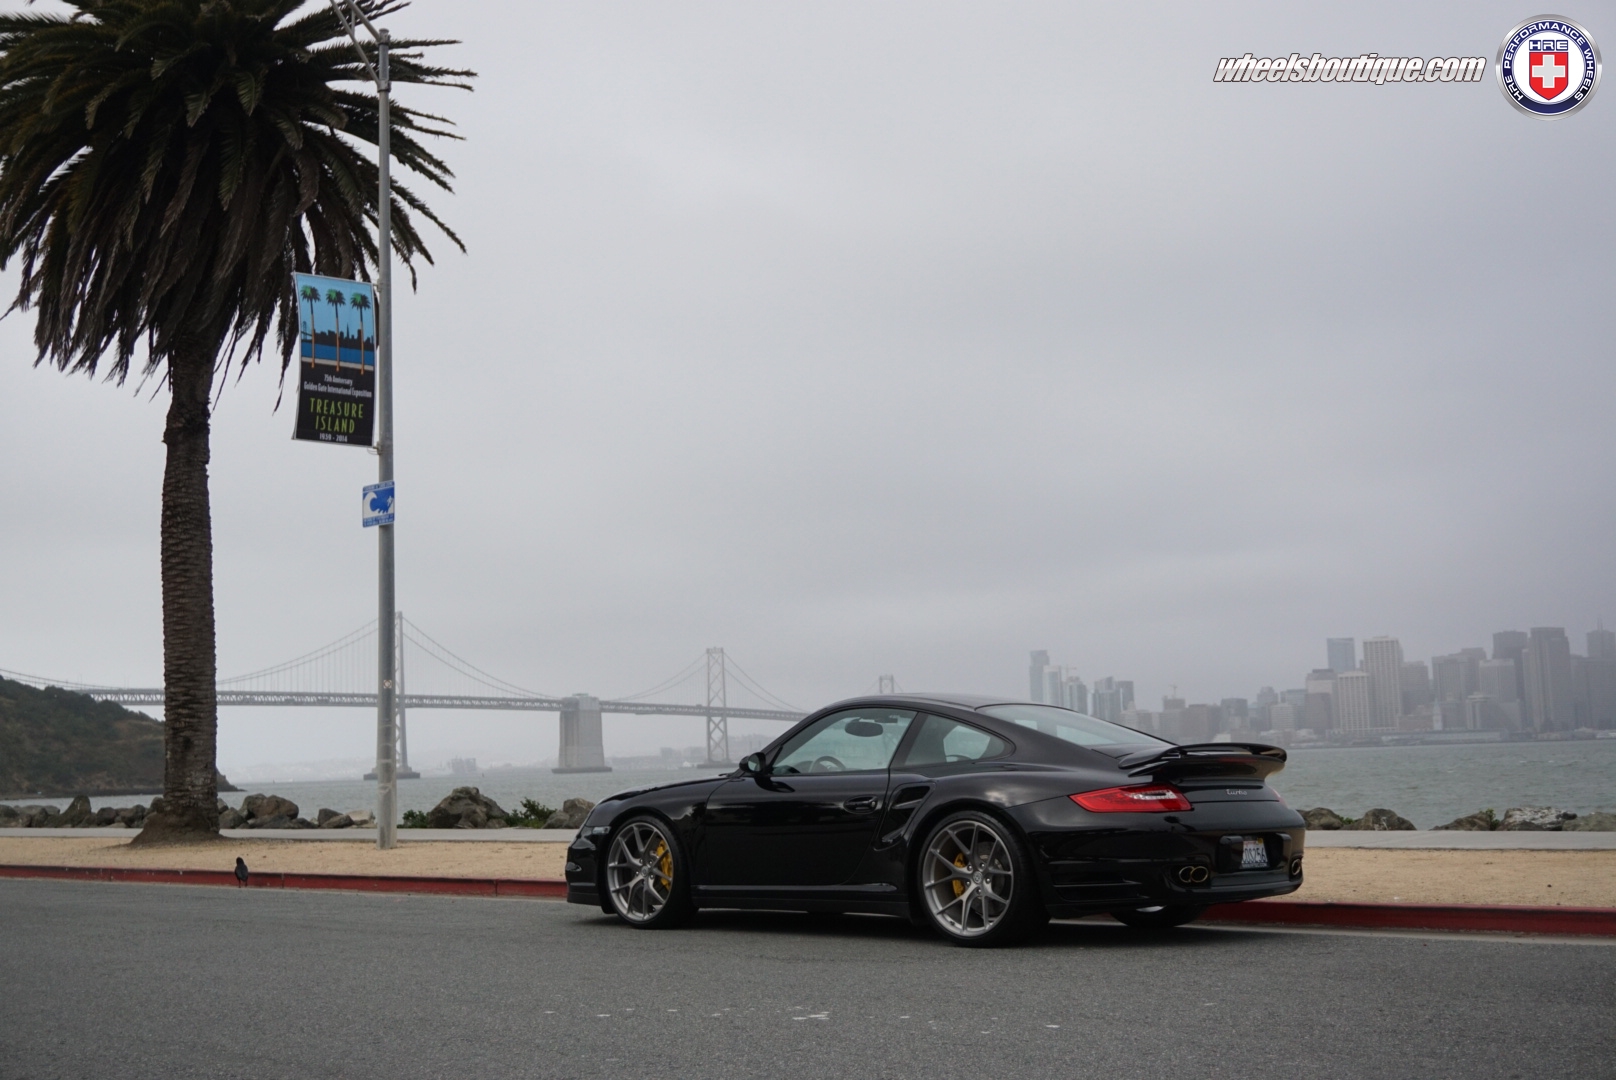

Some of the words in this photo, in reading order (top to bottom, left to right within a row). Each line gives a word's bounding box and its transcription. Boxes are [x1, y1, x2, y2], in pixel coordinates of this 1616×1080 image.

[304, 381, 317, 391] Golden
[318, 383, 327, 392] Gate
[328, 384, 351, 395] International
[352, 387, 372, 398] Exposition
[310, 398, 364, 418] TREASURE
[315, 415, 355, 434] ISLAND
